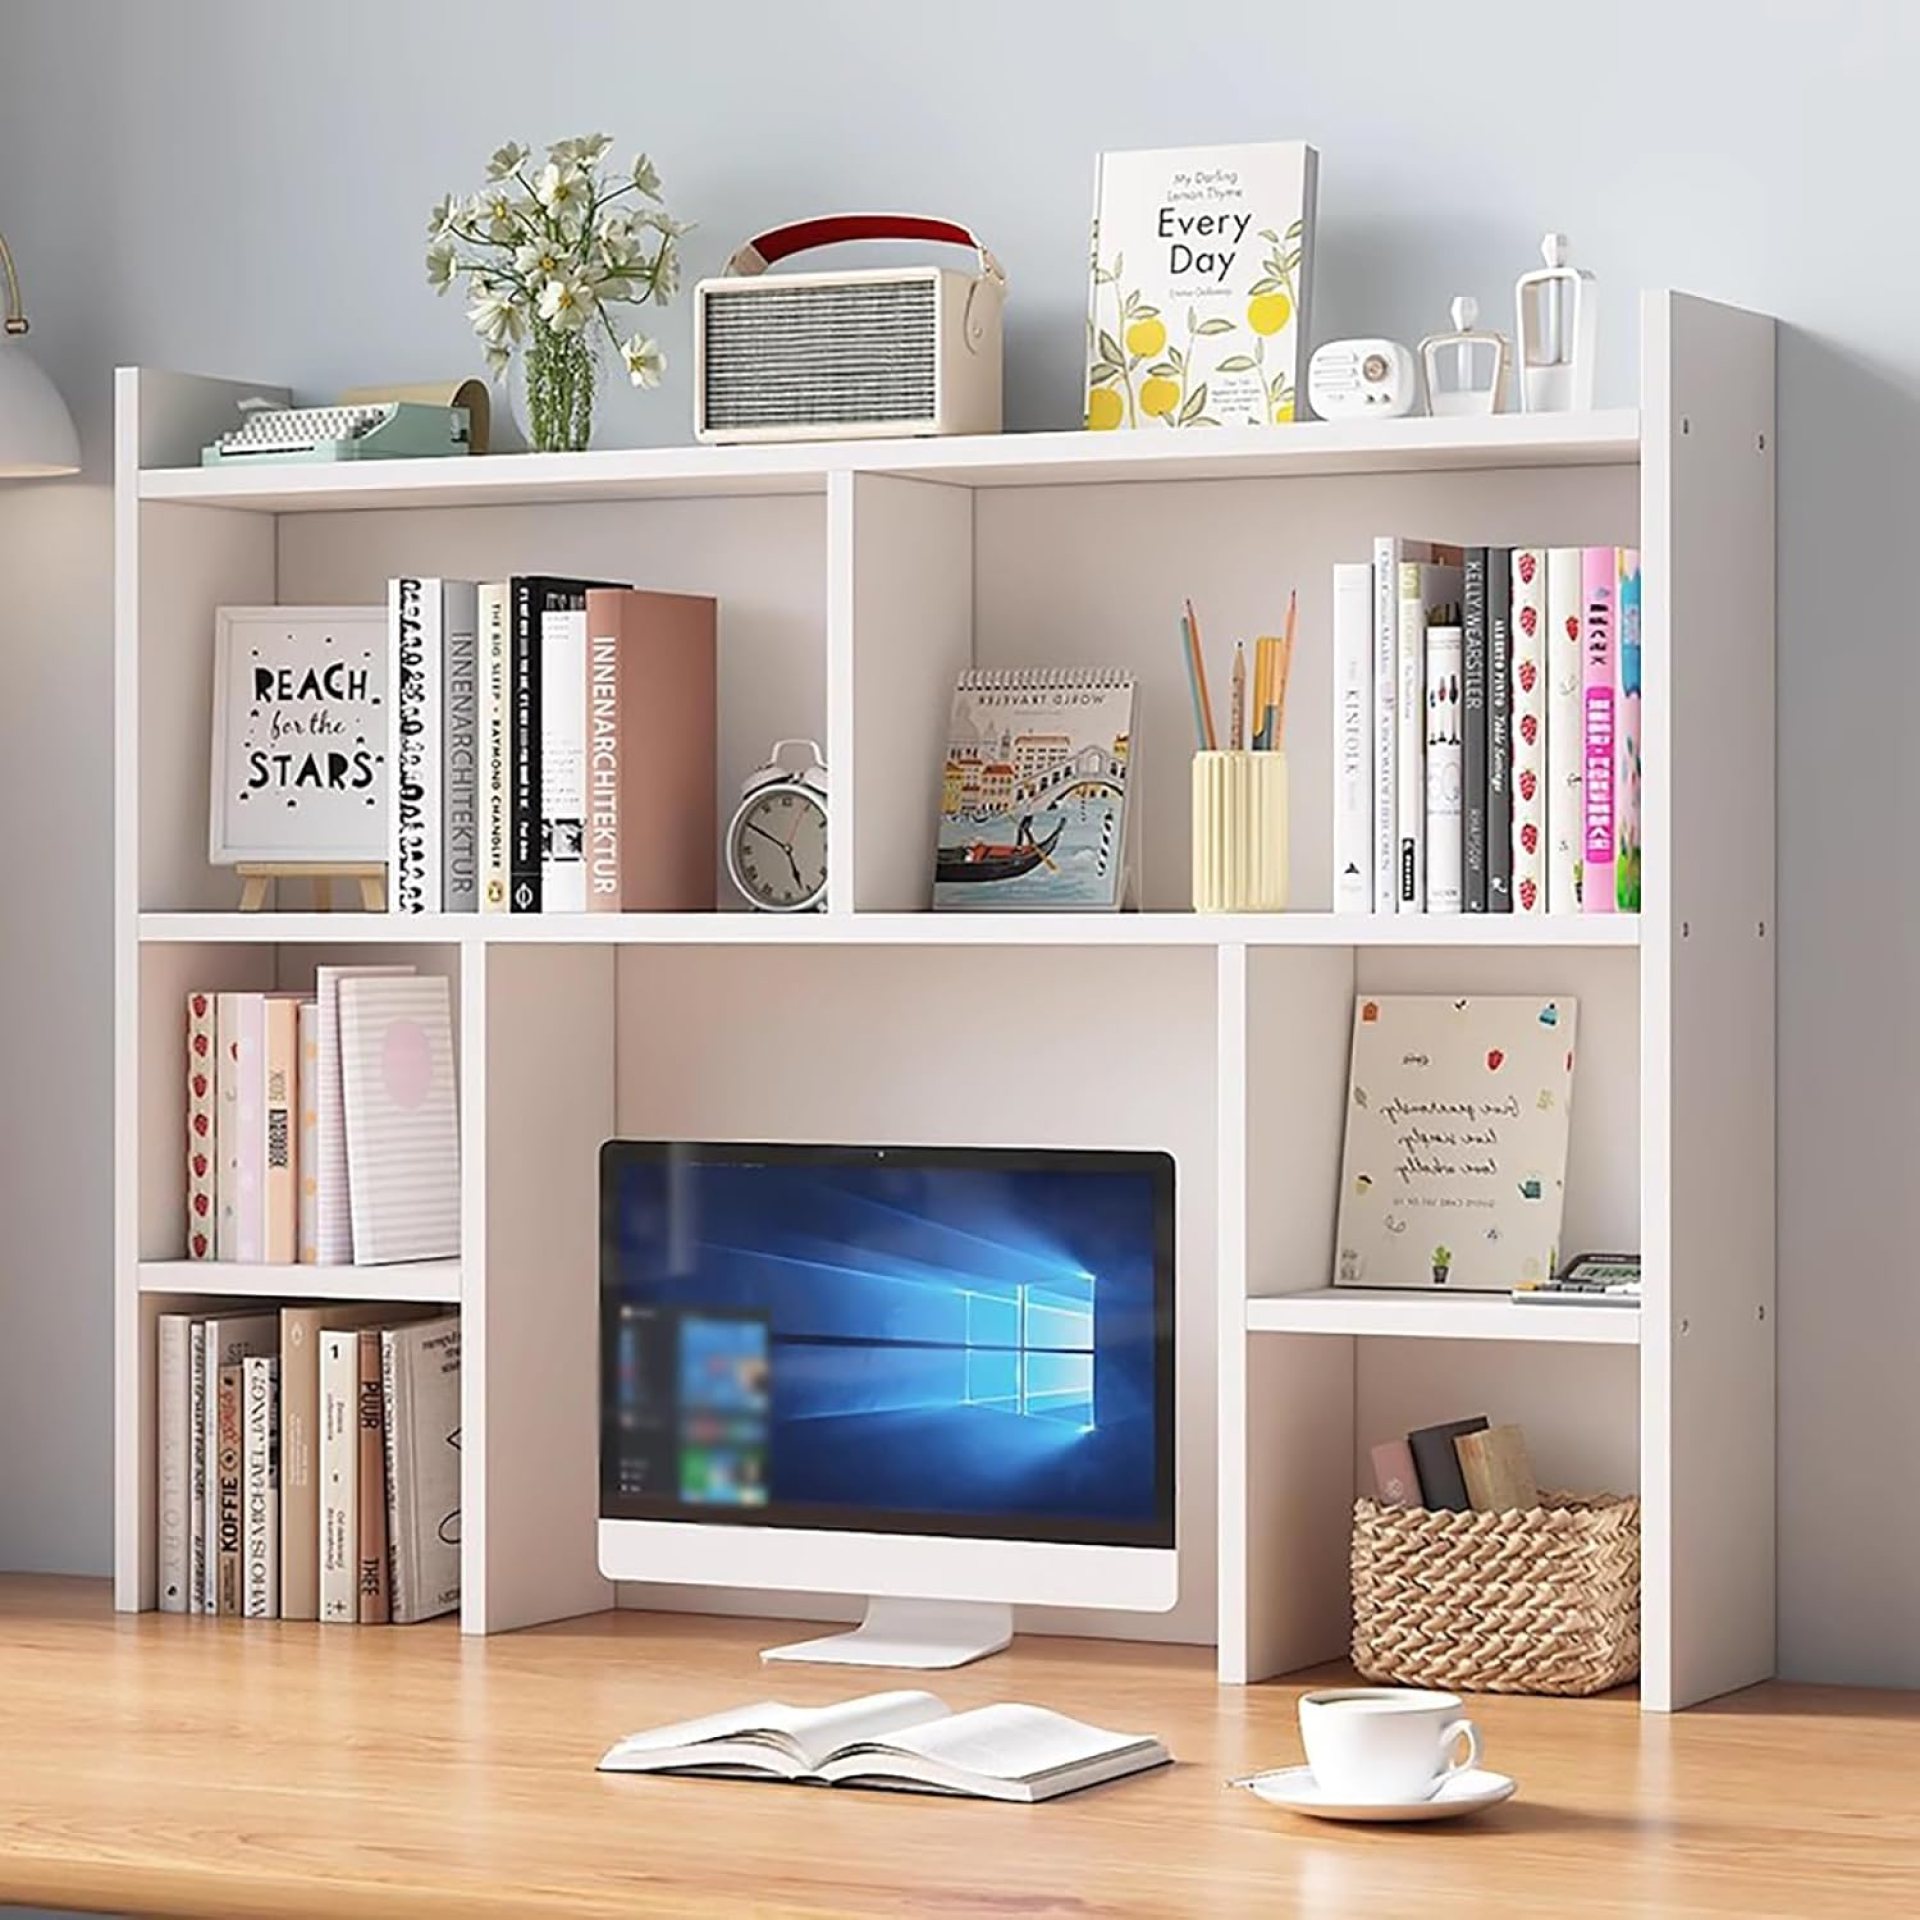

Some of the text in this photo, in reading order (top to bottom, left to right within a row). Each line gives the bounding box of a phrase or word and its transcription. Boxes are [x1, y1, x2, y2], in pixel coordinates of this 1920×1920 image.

[1158, 206, 1252, 243] Every
[1170, 244, 1236, 282] Day
[1466, 561, 1482, 608] KELLY
[255, 663, 368, 702] REACH
[1466, 612, 1482, 709] WEARSTLER
[271, 708, 347, 739] for the
[247, 751, 373, 791] STARS
[451, 631, 474, 895] INNENARCHITEKTUR
[592, 636, 616, 895] INNENARCHITEKTUR
[361, 1380, 381, 1430] PUUR
[220, 1477, 238, 1553] KOFFIE
[251, 1539, 266, 1559] IS
[251, 1562, 266, 1617] WHO
